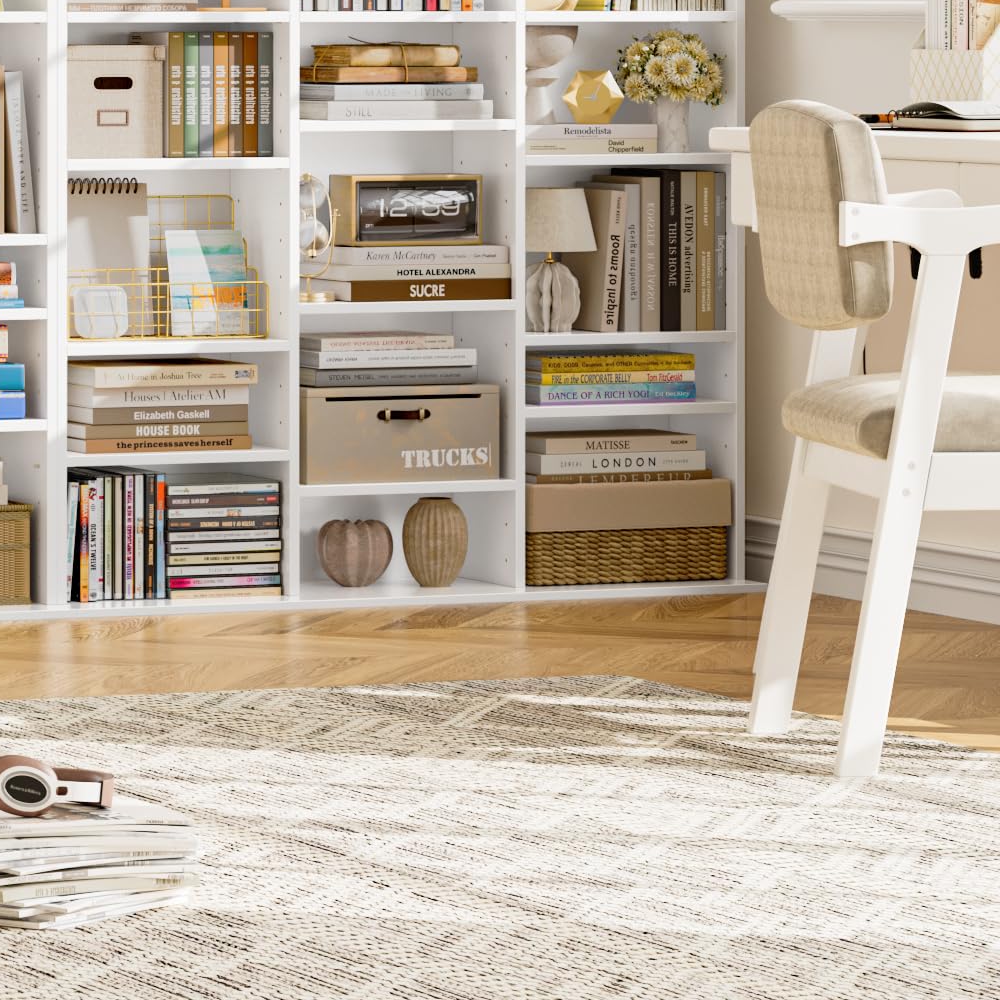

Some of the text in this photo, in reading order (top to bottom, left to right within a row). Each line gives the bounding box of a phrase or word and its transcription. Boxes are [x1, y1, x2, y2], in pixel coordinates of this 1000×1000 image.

[414, 88, 453, 96] LIVING
[345, 106, 372, 117] STILL
[564, 127, 612, 135] Remodelista
[379, 198, 408, 218] 12
[683, 204, 694, 293] AVEDON advertising
[366, 251, 437, 262] Karen McCartney
[668, 222, 677, 287] THIS IS HOME
[426, 268, 476, 276] ALEXANDRA
[410, 284, 445, 297] SUCRE
[552, 375, 562, 384] FIRE
[580, 374, 614, 384] CORPORATE
[615, 373, 631, 383] BELLY
[548, 392, 577, 401] DANCE
[581, 392, 593, 400] OF
[604, 391, 625, 399] RICH
[134, 410, 209, 420] Elizabeth Gaskell
[136, 425, 200, 436] HOUSE BOOK
[586, 441, 630, 450] MATISSE
[401, 447, 488, 468] TRUCKS
[592, 457, 656, 468] LONDON
